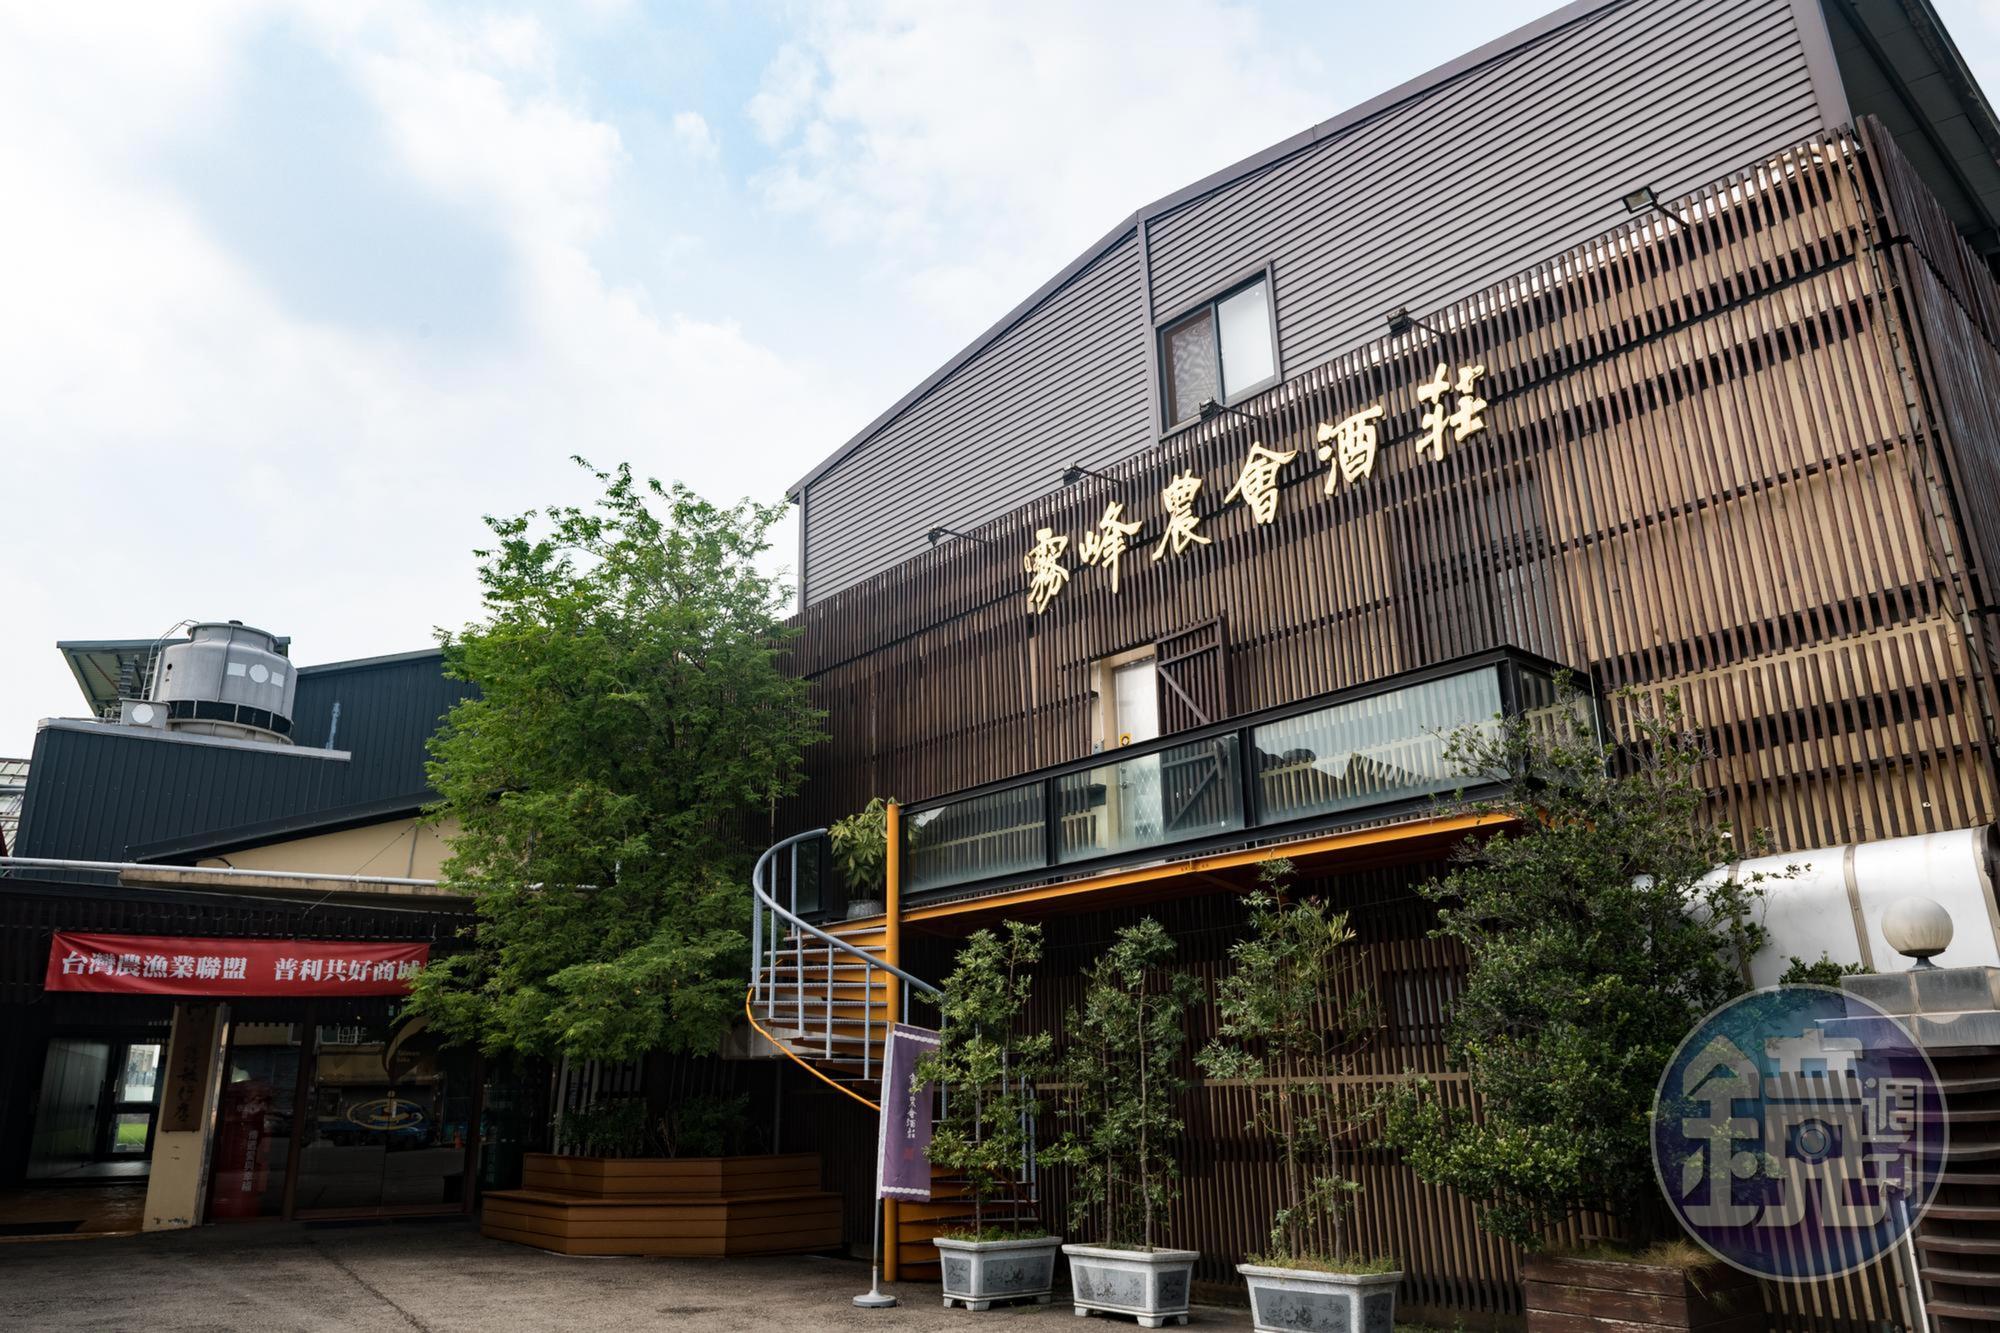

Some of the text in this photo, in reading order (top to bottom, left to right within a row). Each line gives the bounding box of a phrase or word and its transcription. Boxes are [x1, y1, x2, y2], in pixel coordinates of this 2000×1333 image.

[1024, 363, 1488, 615] 霧峰農會酒莊
[61, 951, 248, 980] 台灣農漁業聯盟
